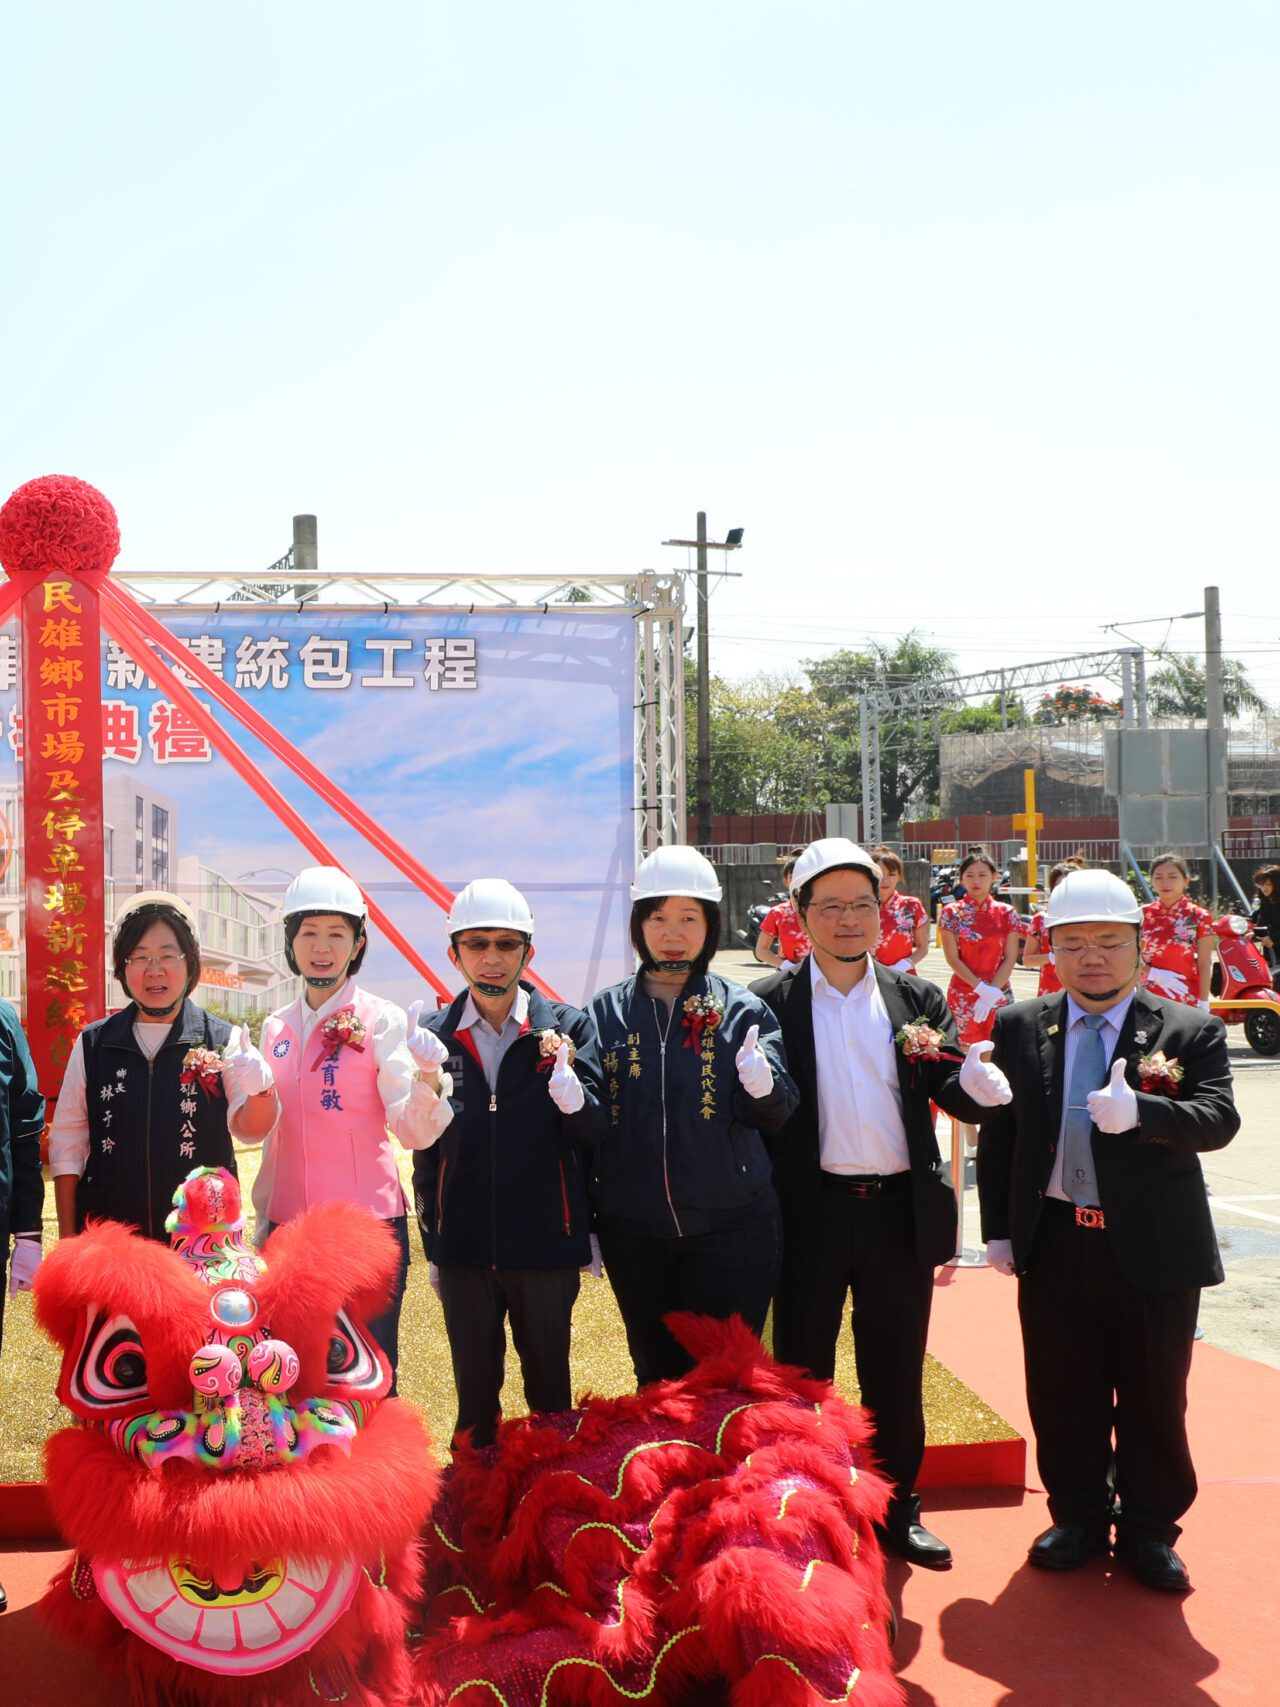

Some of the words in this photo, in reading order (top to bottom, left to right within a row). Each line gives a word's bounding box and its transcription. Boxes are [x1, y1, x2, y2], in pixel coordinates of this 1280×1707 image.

[39, 581, 86, 1083] 民雄鄉市場及停車場新建統包
[115, 1068, 127, 1093] 鄉長
[627, 1032, 642, 1080] 副主席
[320, 1057, 344, 1111] 育敏
[180, 1066, 198, 1160] 雄鄉公所
